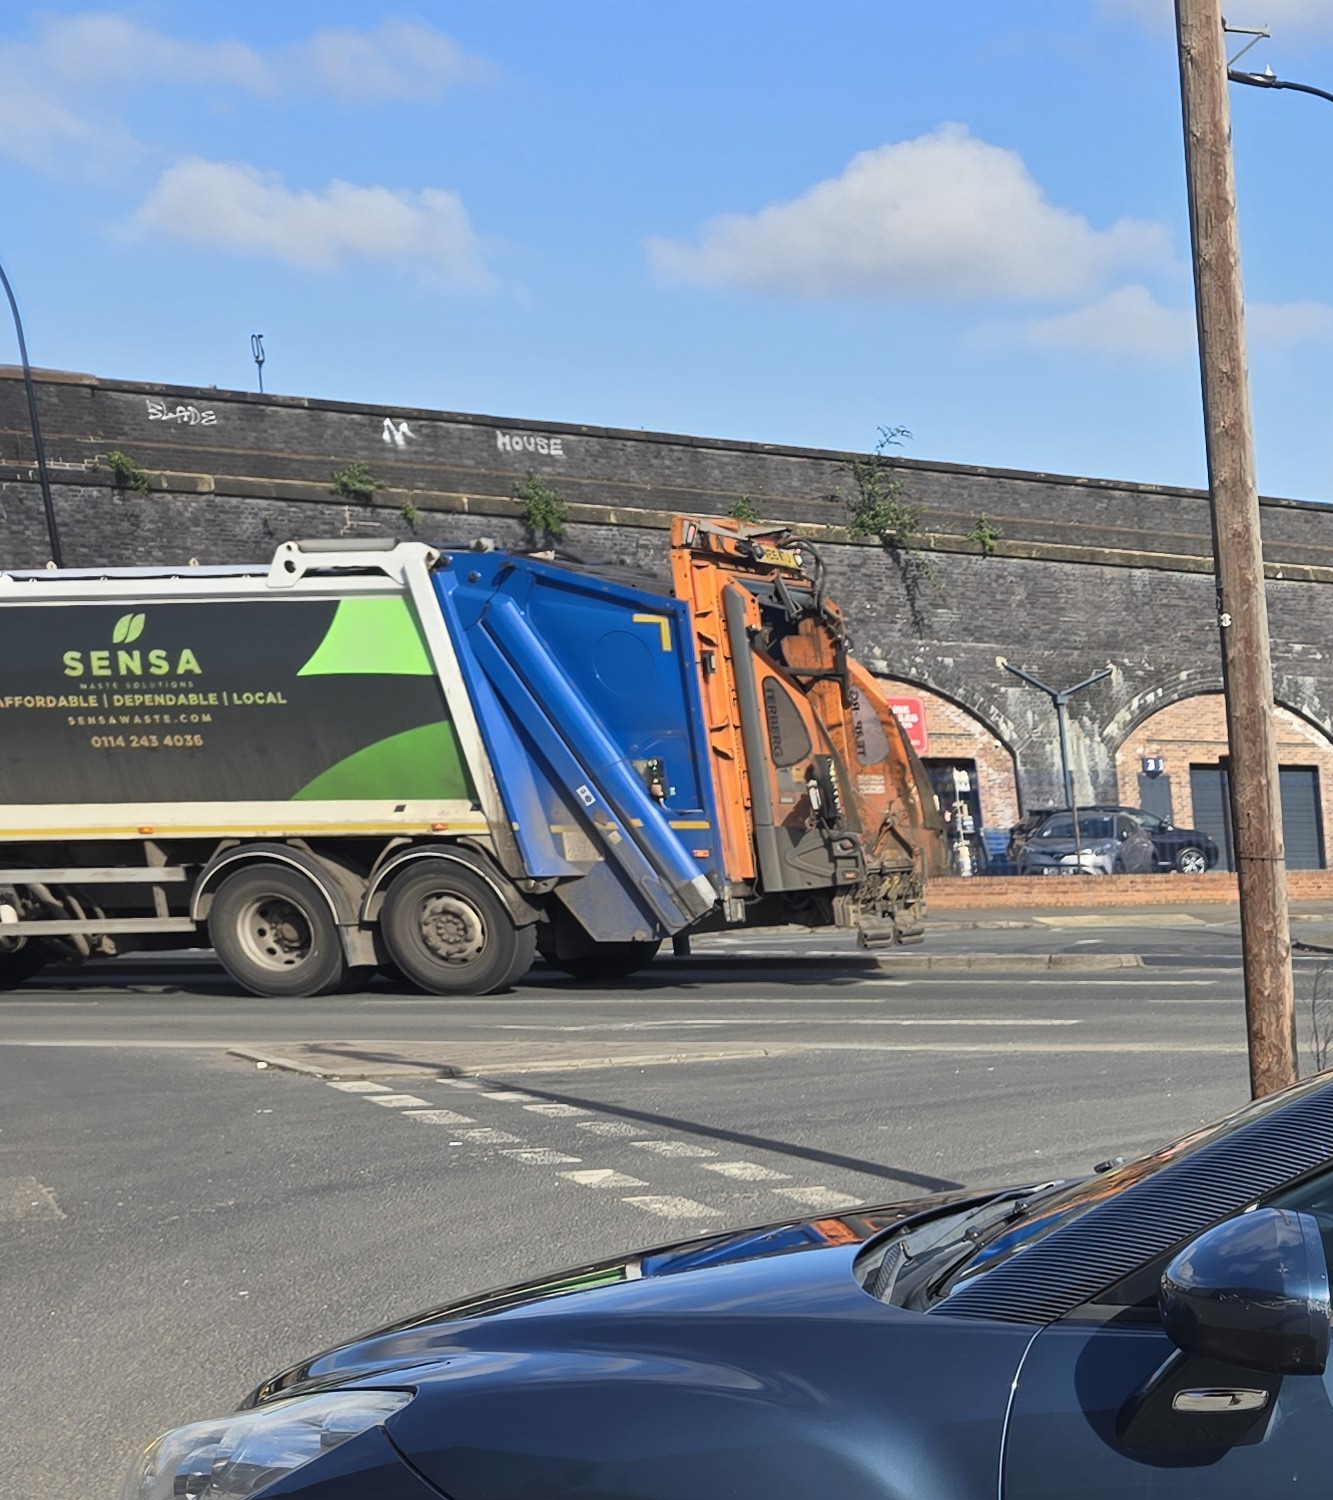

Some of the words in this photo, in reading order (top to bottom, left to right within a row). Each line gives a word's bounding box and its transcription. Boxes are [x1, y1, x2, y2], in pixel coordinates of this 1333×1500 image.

[63, 649, 202, 677] SENSA
[80, 682, 118, 690] WASTE
[126, 681, 194, 689] SOLUTIONS
[113, 693, 219, 707] DEPENDABLE
[232, 691, 287, 705] LOCAL
[68, 713, 212, 726] SENSAWASTE.COM
[91, 736, 125, 748] 0114
[130, 735, 158, 747] 243
[163, 734, 203, 747] 4036
